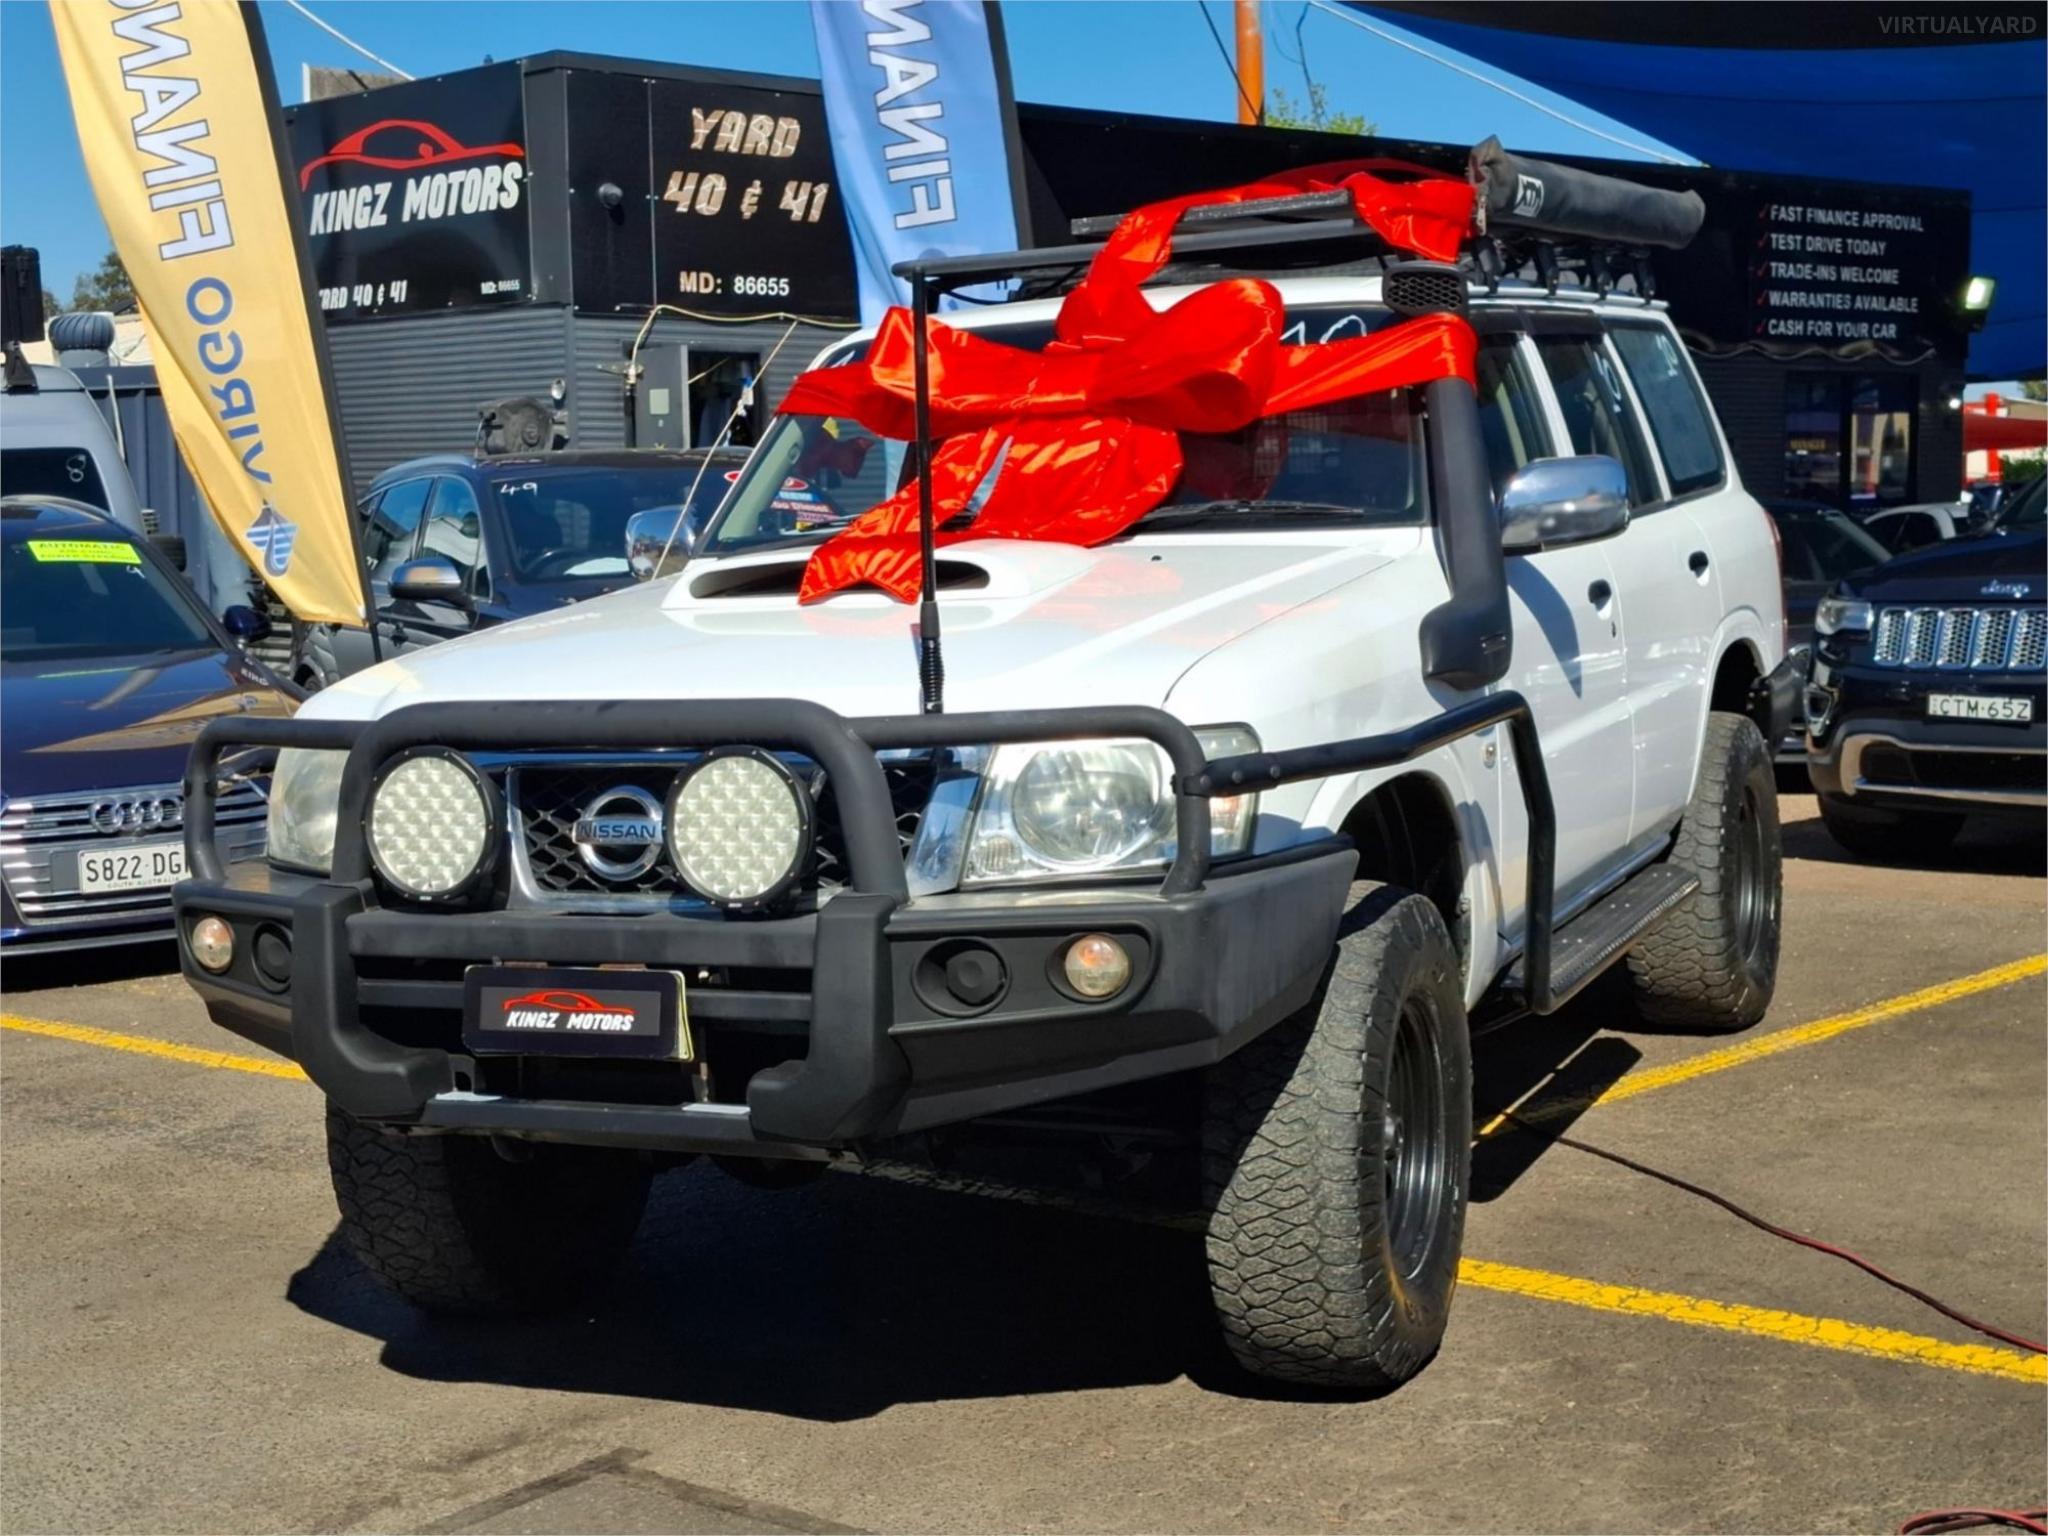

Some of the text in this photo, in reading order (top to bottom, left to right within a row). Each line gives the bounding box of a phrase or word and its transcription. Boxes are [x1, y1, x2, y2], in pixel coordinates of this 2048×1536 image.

[690, 107, 801, 157] YARD
[310, 161, 523, 236] KINGZ MOTORS
[663, 171, 727, 216] 40
[779, 180, 829, 223] 41
[1770, 205, 1924, 232] FAST FINANCE APPROVAL
[1770, 233, 1886, 256] TEST DRIVE TODAY
[679, 271, 790, 296] MD: 86655
[1769, 262, 1899, 285] TRADE-INS WELCOME
[353, 282, 373, 307] 40
[390, 280, 408, 303] 41
[1769, 290, 1918, 313] WARRANTIES AVAILABLE
[1768, 319, 1897, 339] CASH FOR YOUR CAR
[500, 482, 538, 496] 49
[580, 824, 656, 839] NISSAN
[506, 1010, 635, 1031] KINGZ MOTORS
